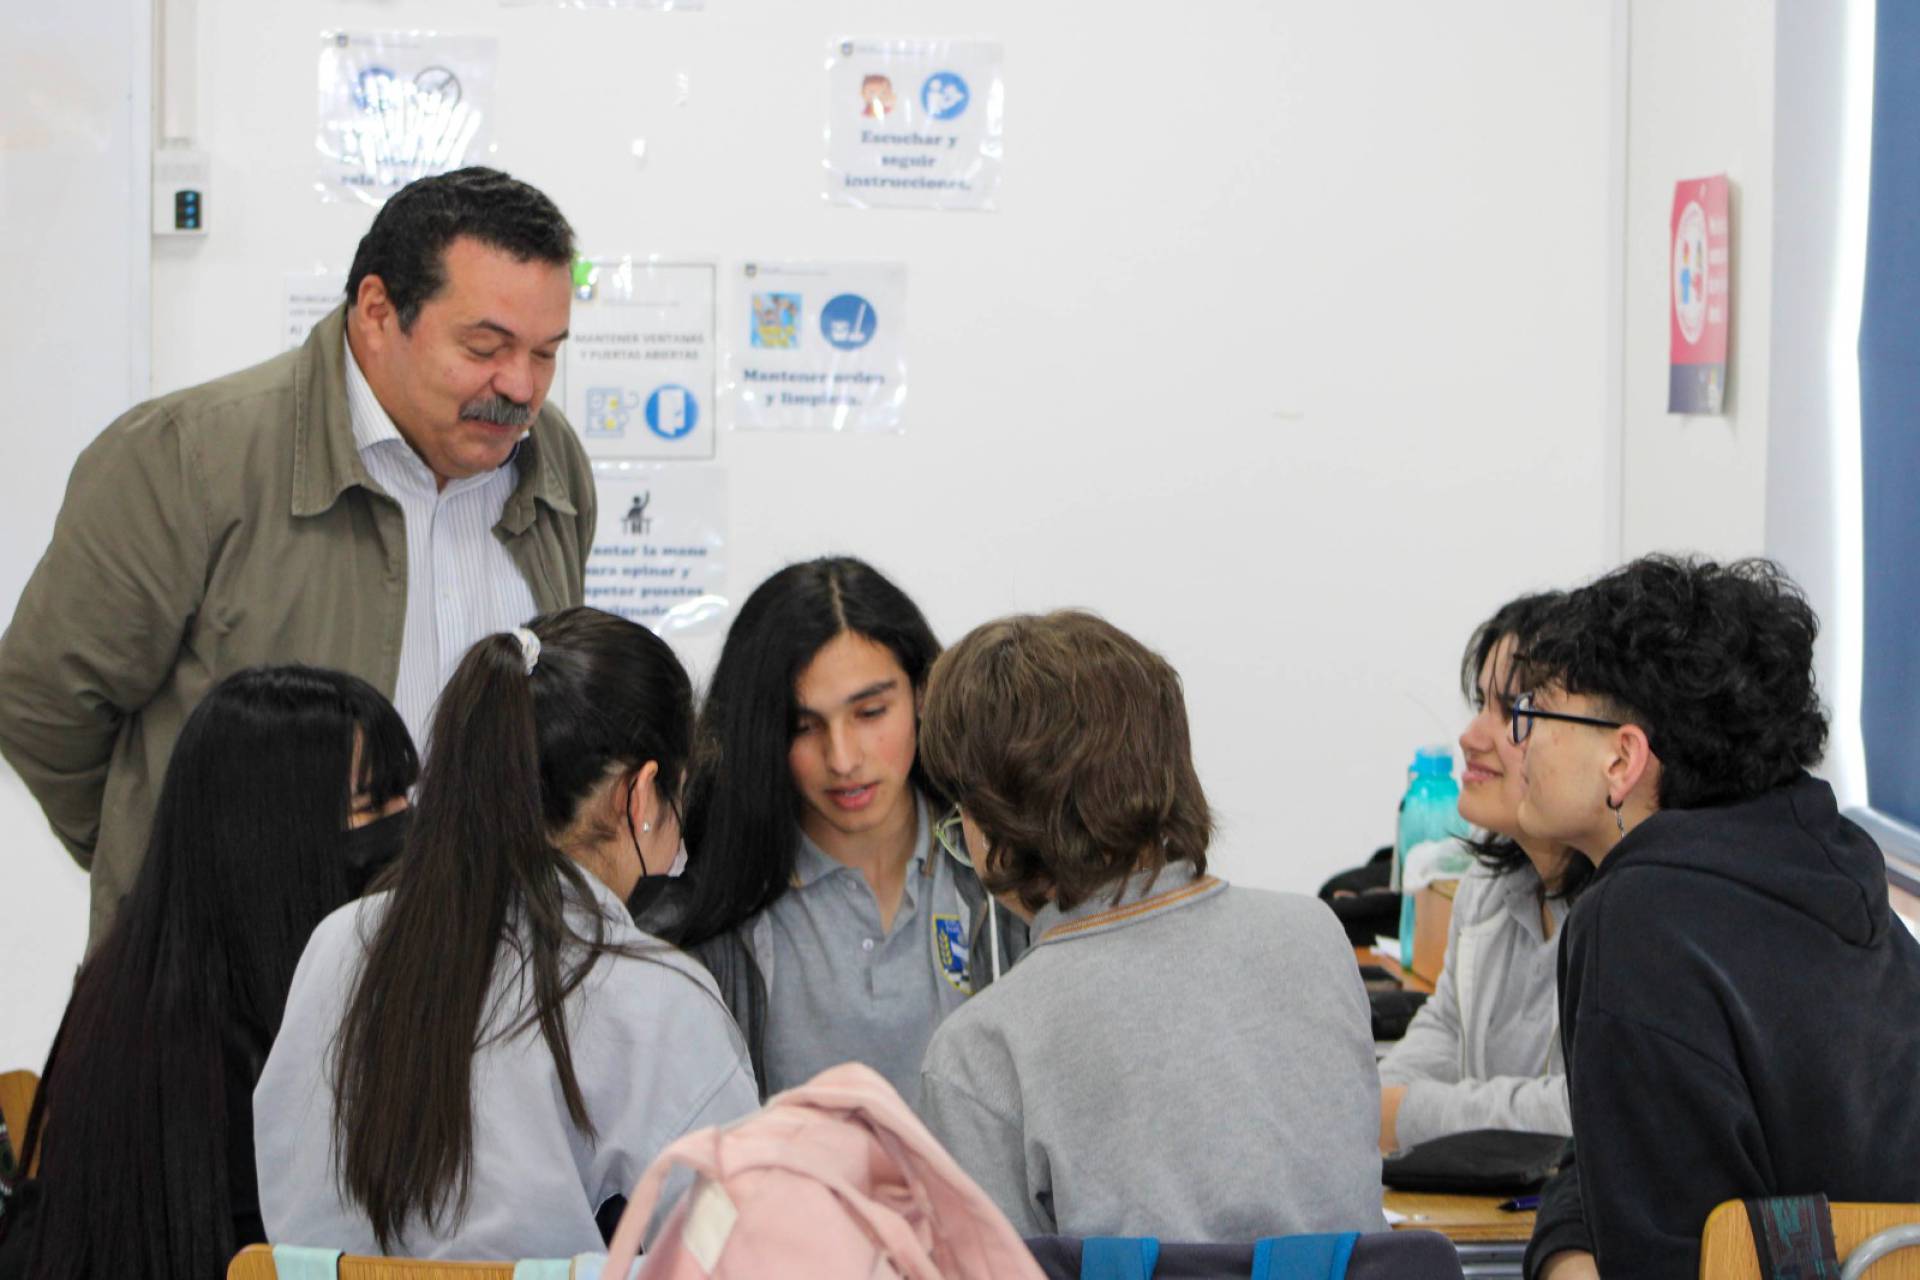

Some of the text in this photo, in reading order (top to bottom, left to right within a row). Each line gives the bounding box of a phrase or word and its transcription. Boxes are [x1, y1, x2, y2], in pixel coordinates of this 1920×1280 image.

[861, 129, 959, 149] Escuchar y
[881, 154, 937, 169] seguir
[743, 368, 827, 383] Mantener
[642, 544, 657, 556] la
[661, 546, 708, 556] mano
[622, 565, 675, 578] opinar
